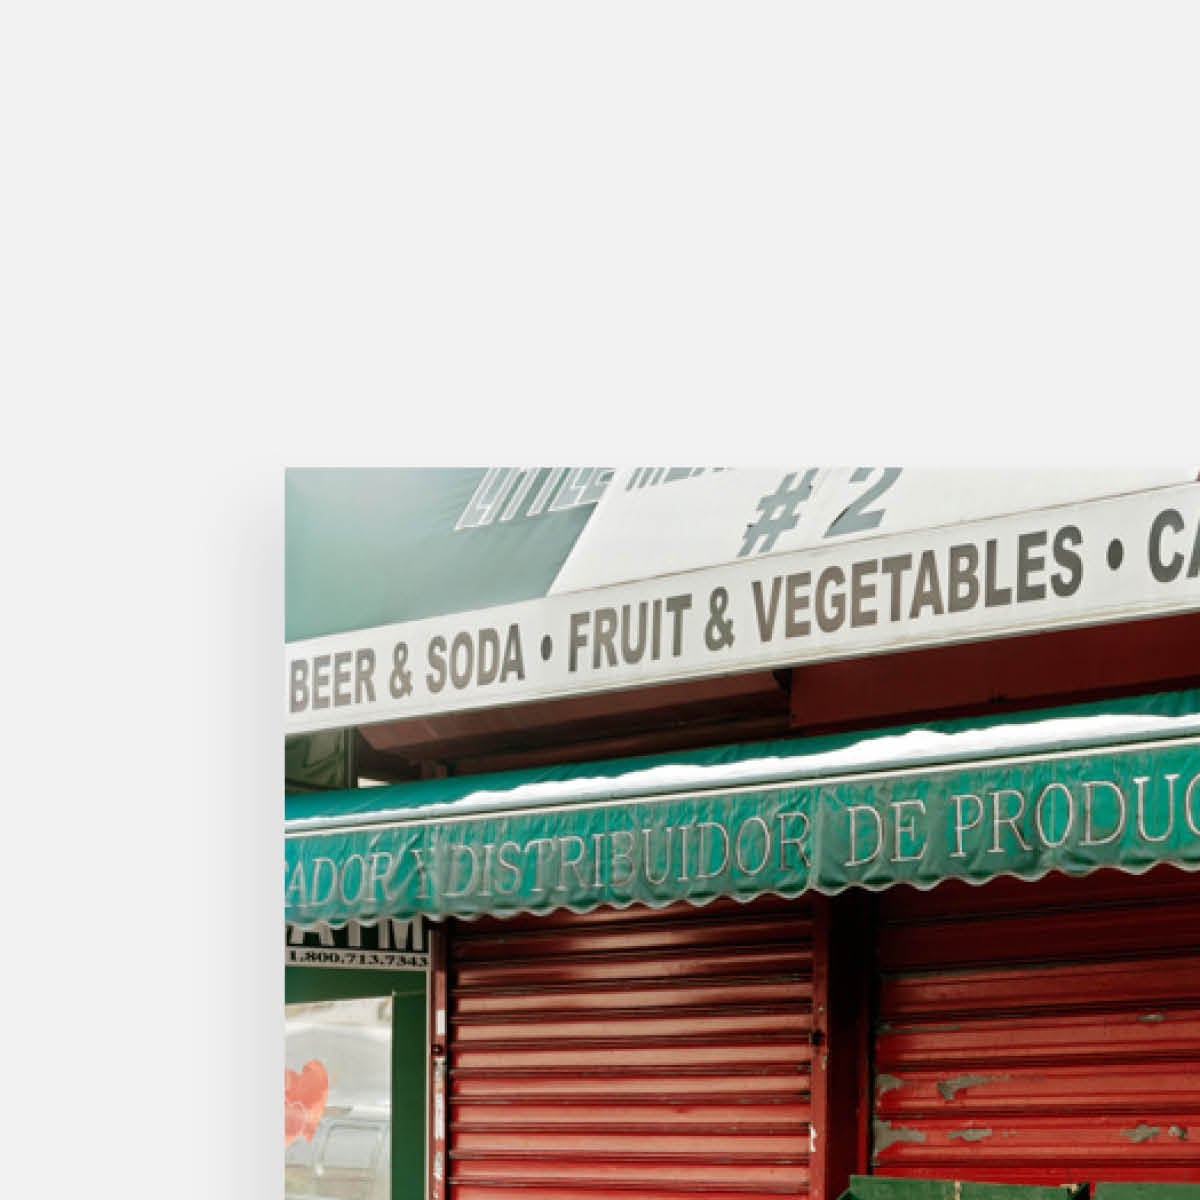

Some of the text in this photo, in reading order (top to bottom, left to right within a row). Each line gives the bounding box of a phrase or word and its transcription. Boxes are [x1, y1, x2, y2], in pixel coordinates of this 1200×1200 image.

[289, 648, 377, 713] BEER
[389, 641, 413, 699] &
[425, 623, 526, 693] SODA
[568, 593, 693, 672] FRUIT
[704, 586, 735, 651] &
[751, 524, 1084, 643] VEGETABLES
[285, 850, 395, 907] ADOR
[440, 811, 812, 897] DISTRIBUIDOR
[845, 800, 926, 867] DE
